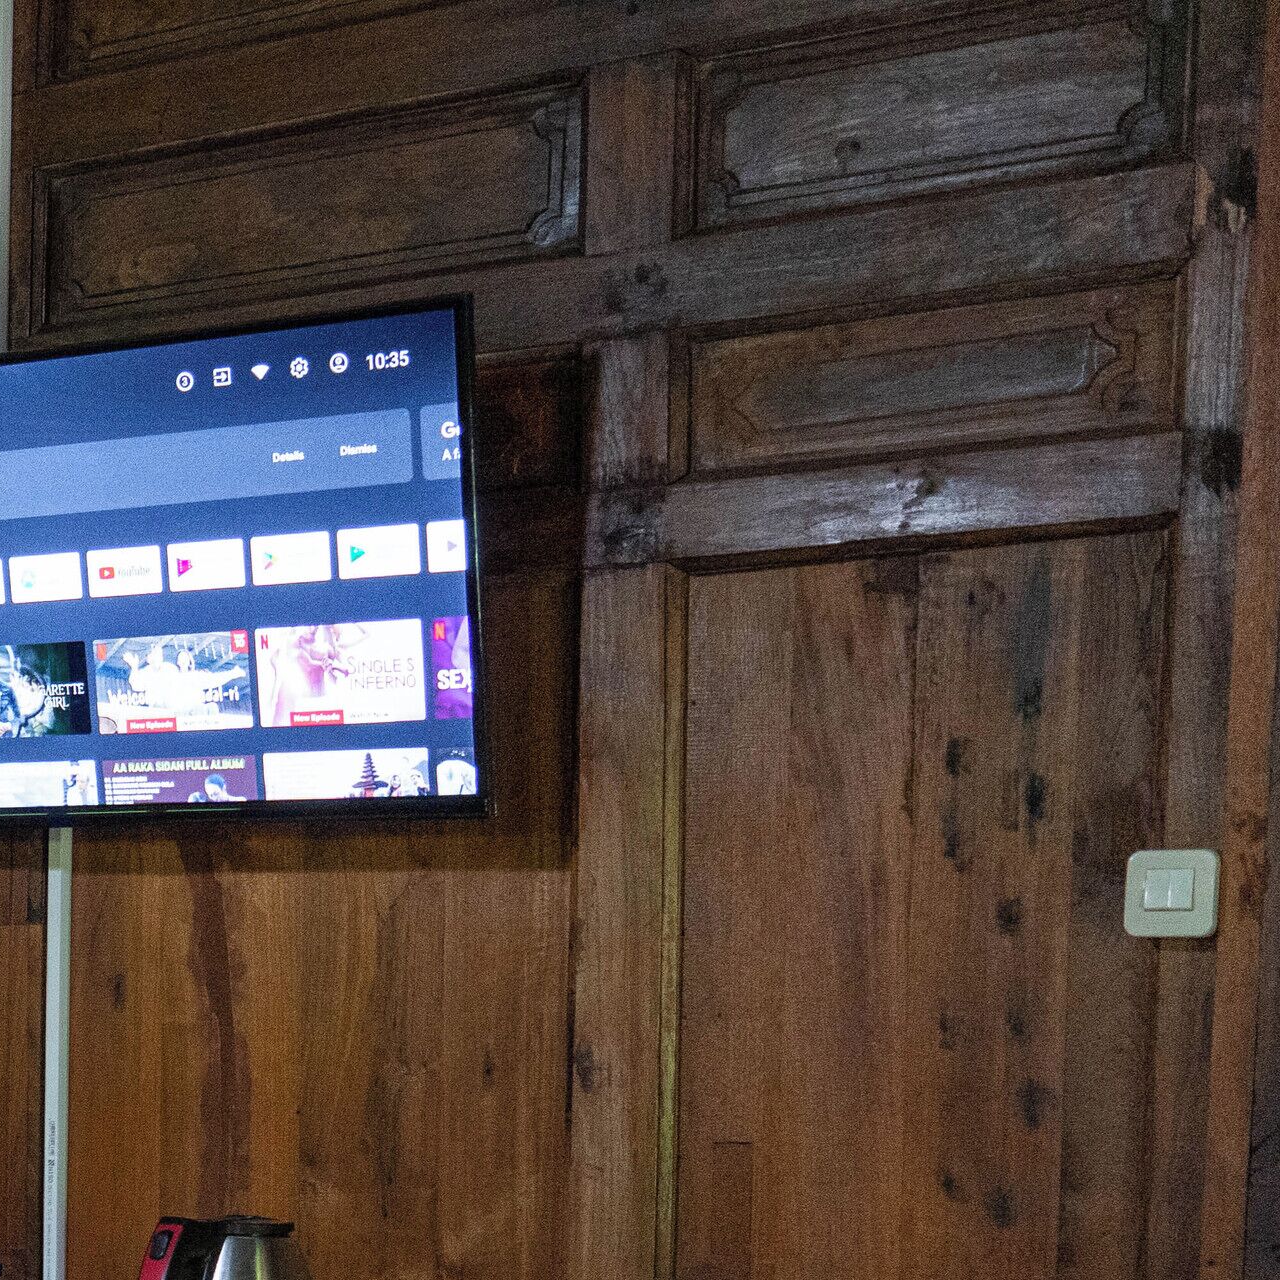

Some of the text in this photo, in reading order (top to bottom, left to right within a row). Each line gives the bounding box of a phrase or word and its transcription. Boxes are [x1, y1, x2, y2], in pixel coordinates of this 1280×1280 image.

[366, 350, 410, 370] 10:35
[272, 450, 305, 463] Details
[339, 443, 377, 456] Dismiss
[349, 674, 417, 690] INFERNO
[44, 696, 70, 710] GIRL
[113, 762, 127, 773] AA
[128, 761, 154, 772] RAKA
[186, 759, 209, 771] FULL
[210, 758, 245, 769] ALBUM
